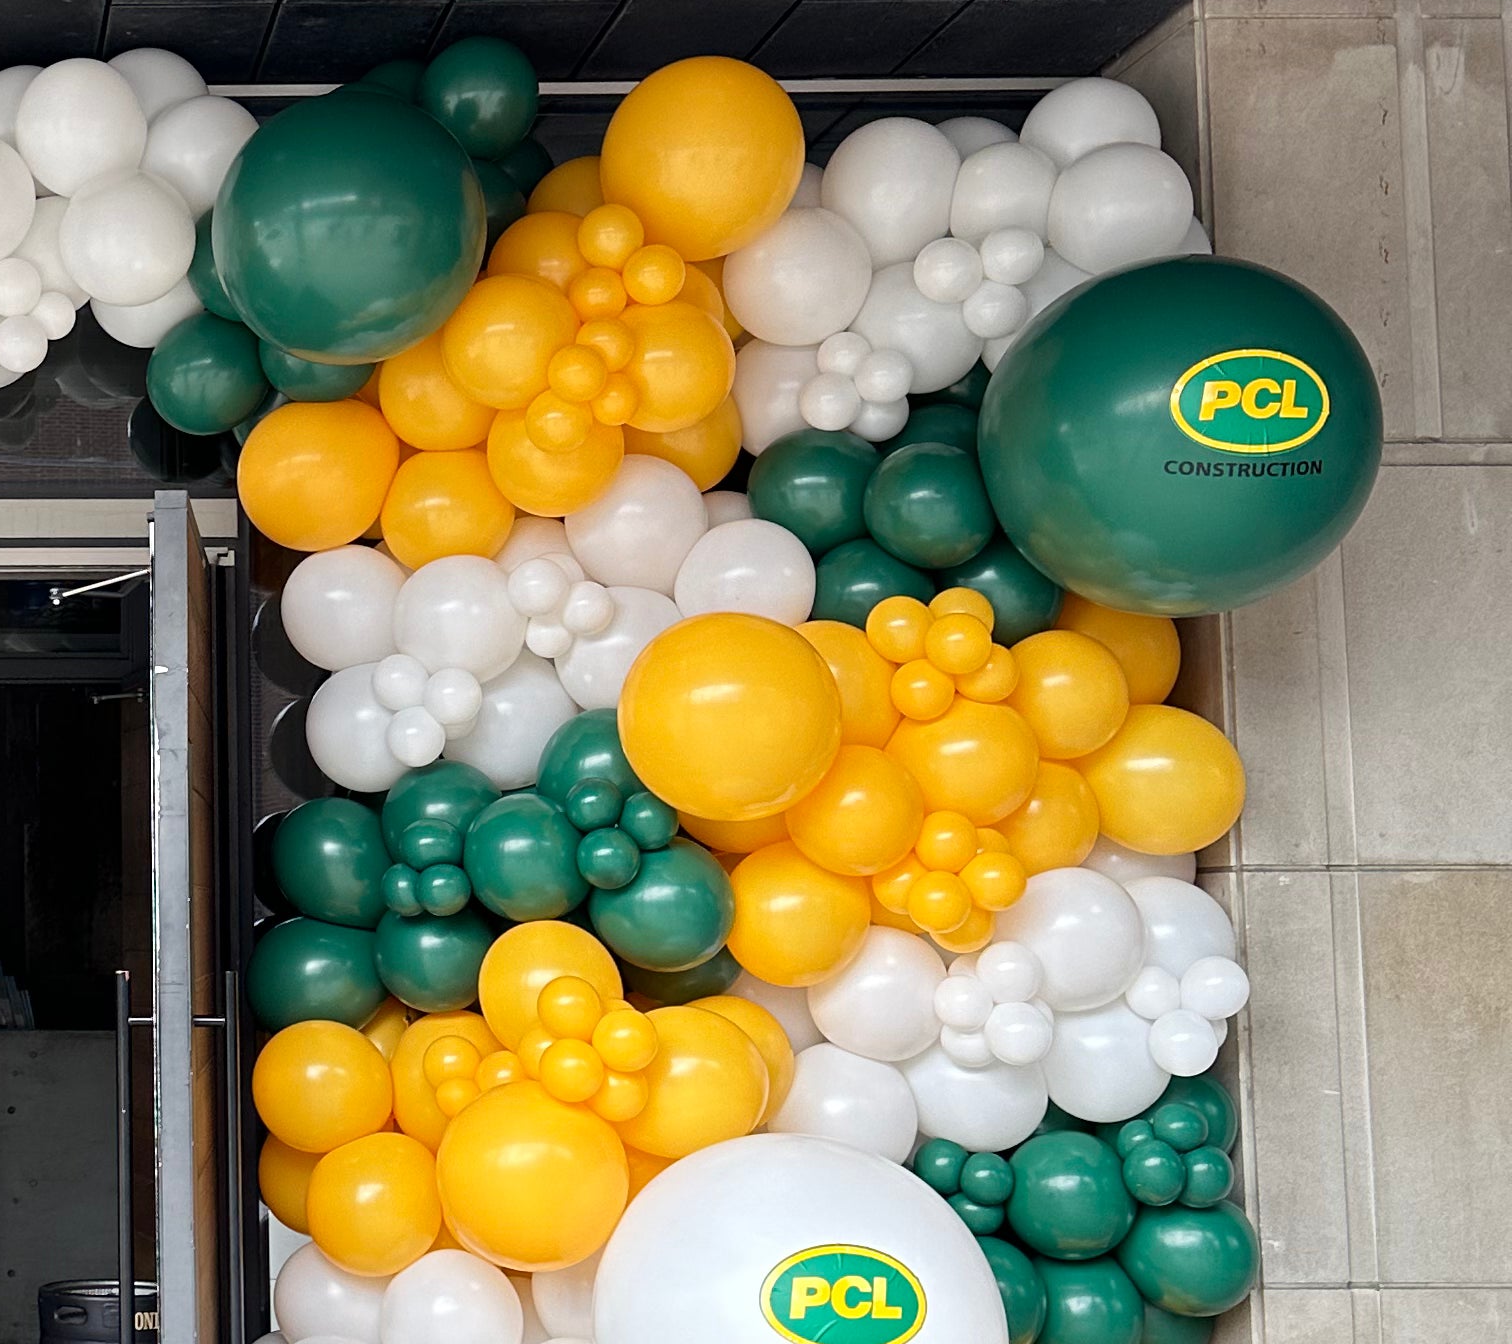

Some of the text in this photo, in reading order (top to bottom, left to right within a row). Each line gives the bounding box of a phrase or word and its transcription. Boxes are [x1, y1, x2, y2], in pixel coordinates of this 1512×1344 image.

[1198, 377, 1309, 422] PCL
[1163, 459, 1323, 478] CONSTRUCTION
[789, 1275, 903, 1320] PCL
